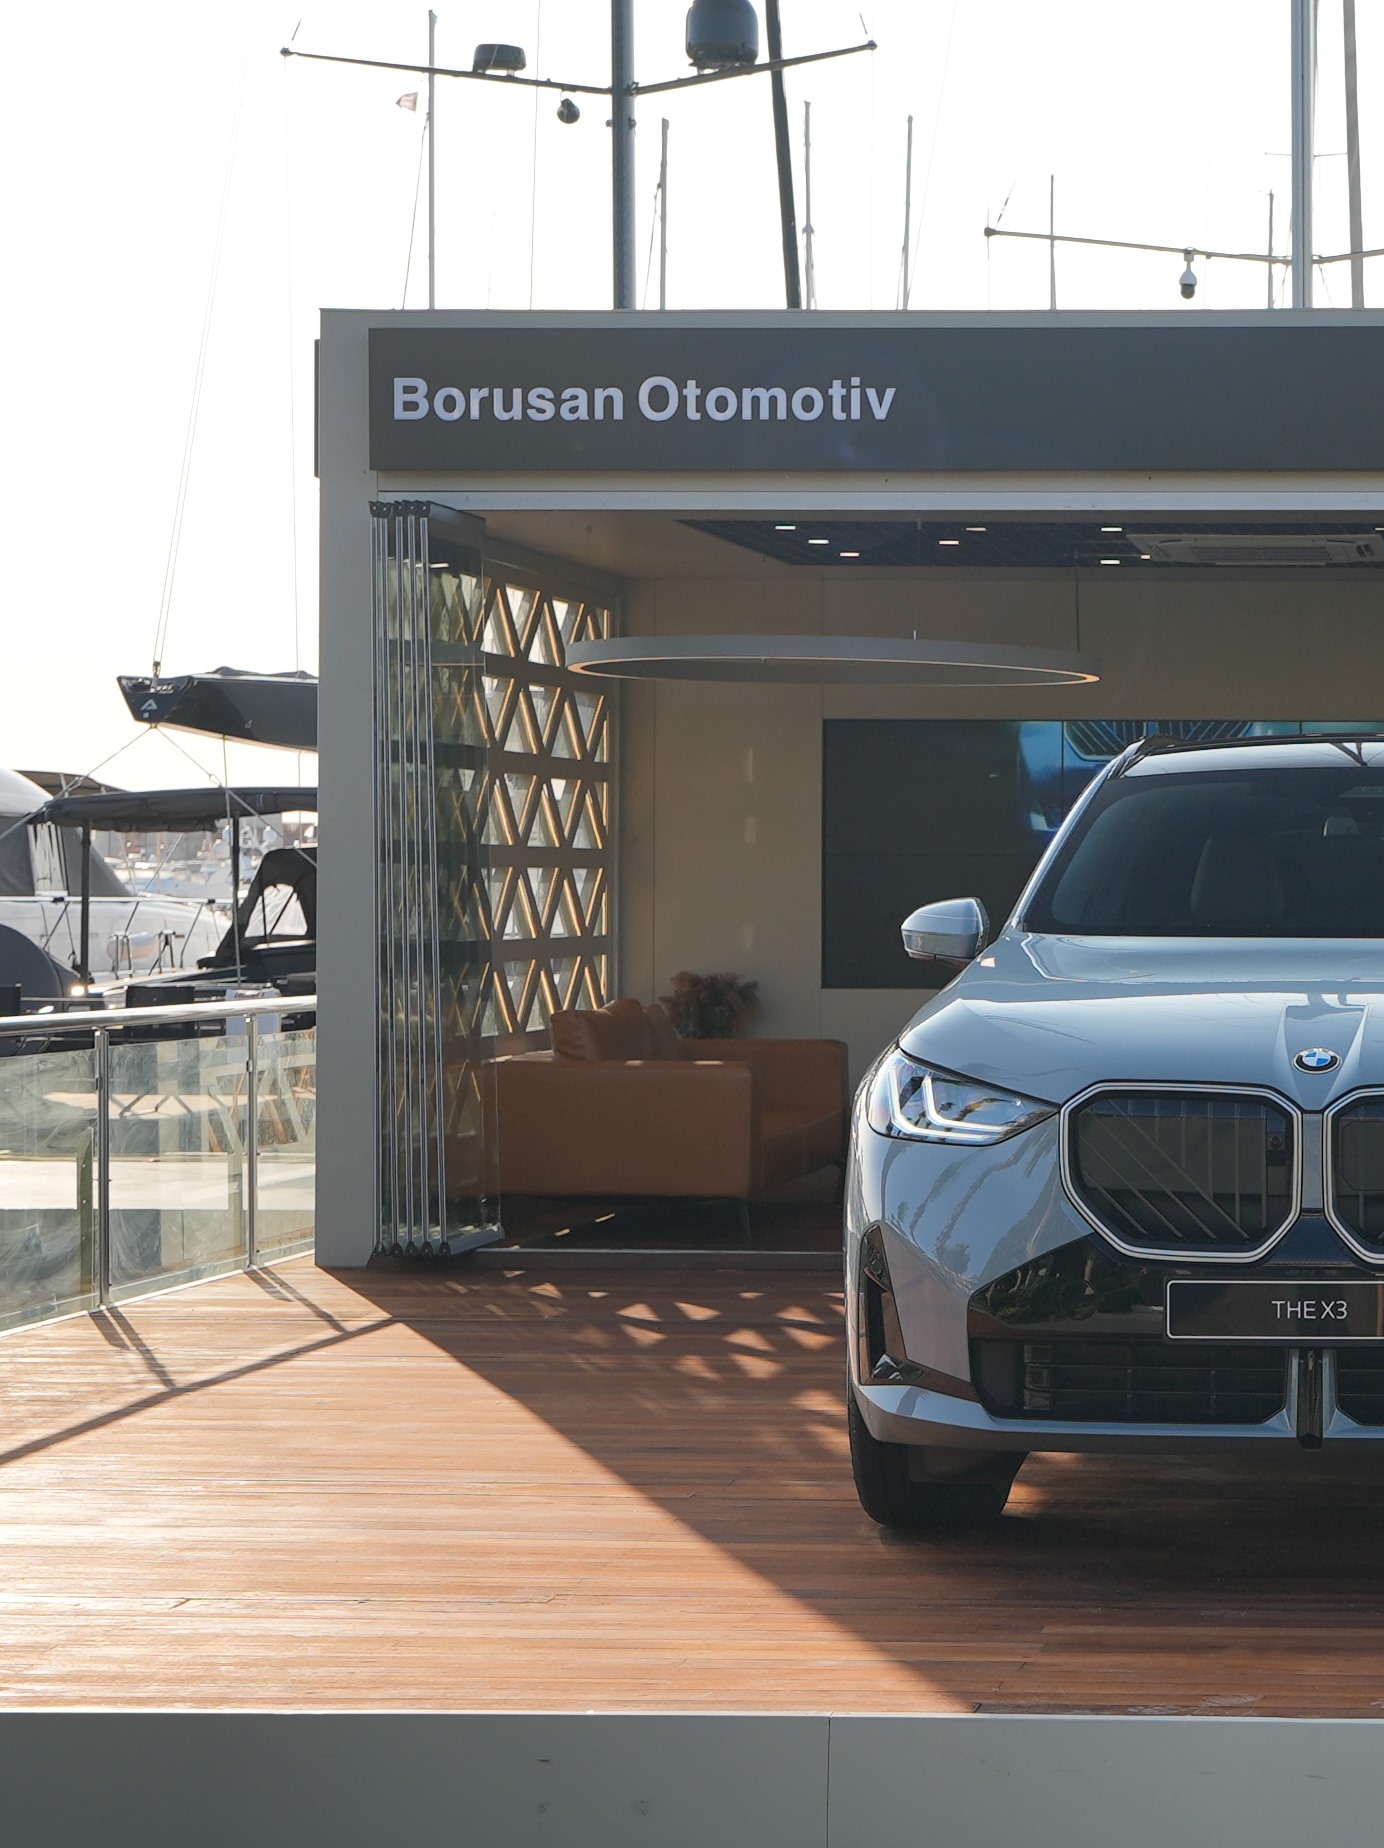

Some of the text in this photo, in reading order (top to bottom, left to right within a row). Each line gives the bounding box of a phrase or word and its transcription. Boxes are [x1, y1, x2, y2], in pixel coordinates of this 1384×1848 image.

[393, 376, 897, 422] Borusan Otomotiv
[1271, 1299, 1349, 1320] THE X3
